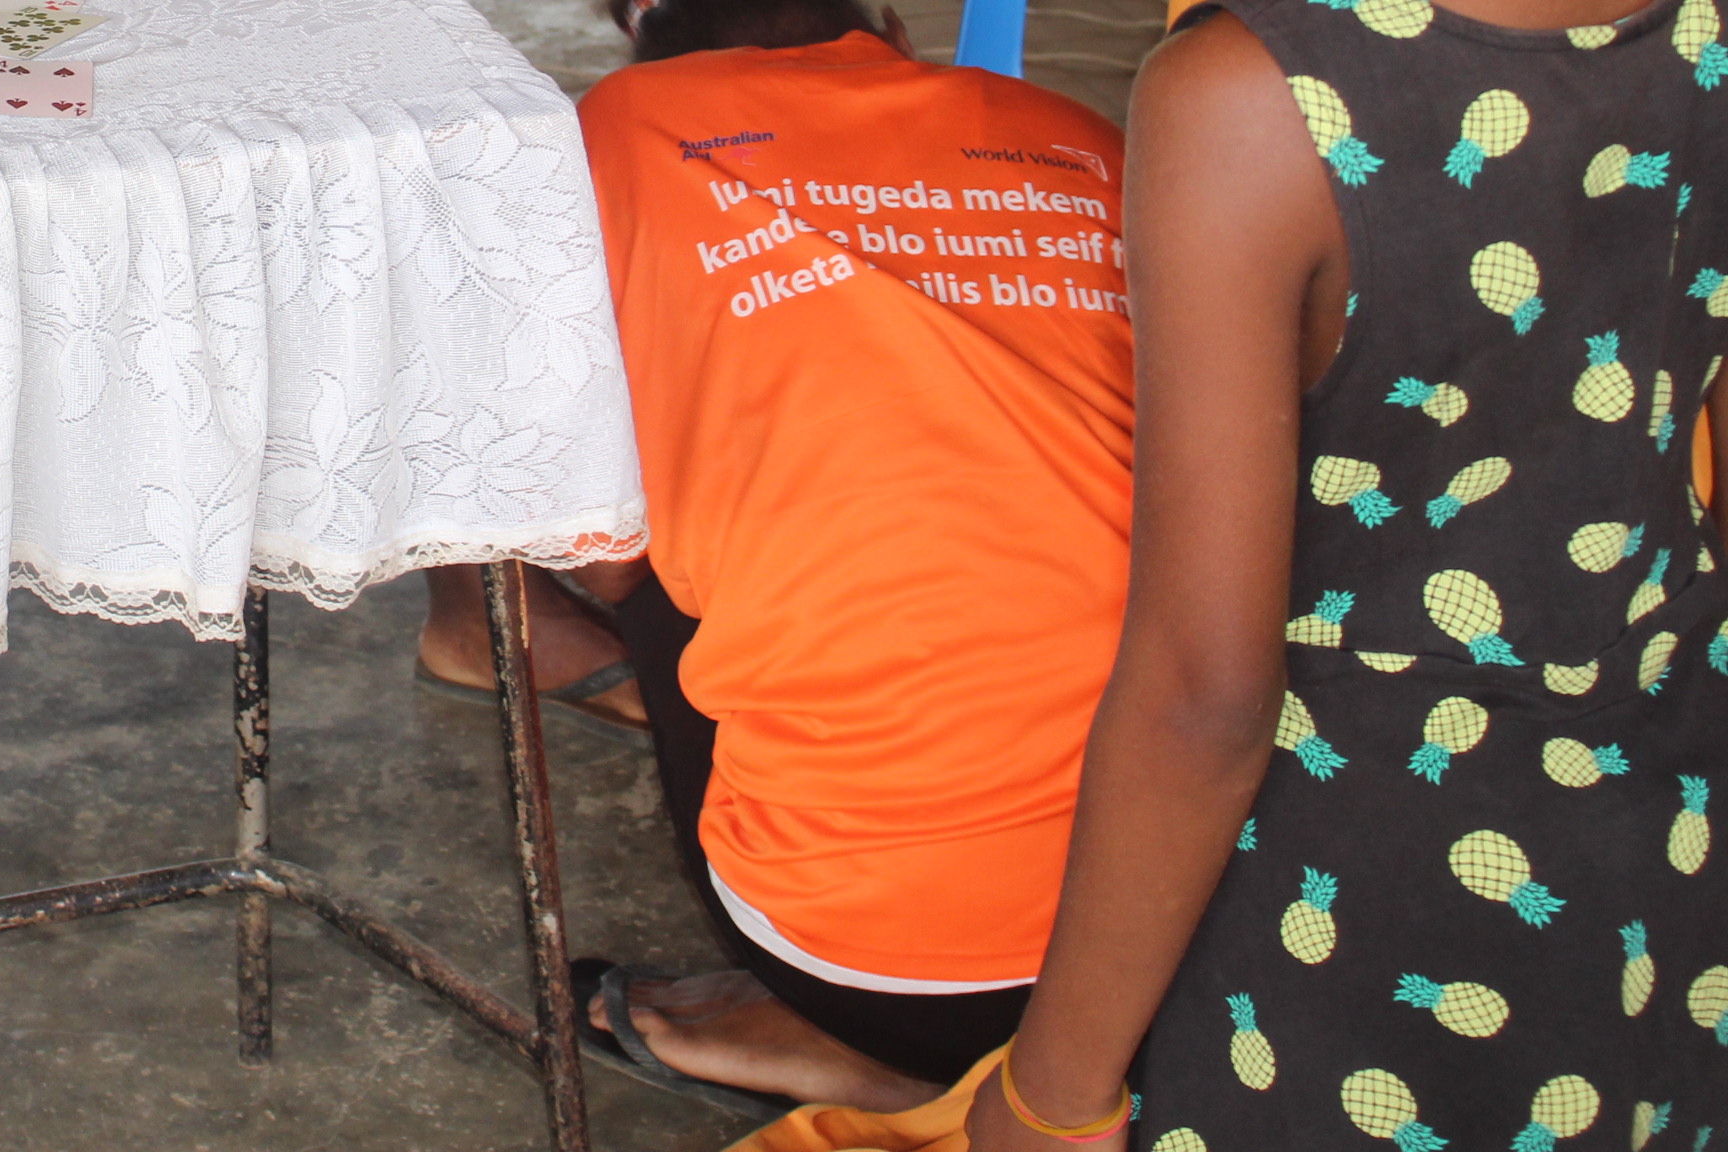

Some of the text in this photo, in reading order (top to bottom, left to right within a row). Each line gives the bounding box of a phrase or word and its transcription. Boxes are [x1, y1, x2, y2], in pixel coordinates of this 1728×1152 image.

[679, 131, 775, 151] Australian
[961, 147, 1088, 174] World Vision
[804, 180, 954, 215] tugeda
[961, 181, 1108, 221] mekem
[856, 223, 926, 256] blo
[933, 227, 1028, 258] iumi
[1036, 231, 1104, 264] seif
[730, 253, 856, 318] olketa
[988, 273, 1057, 308] blo
